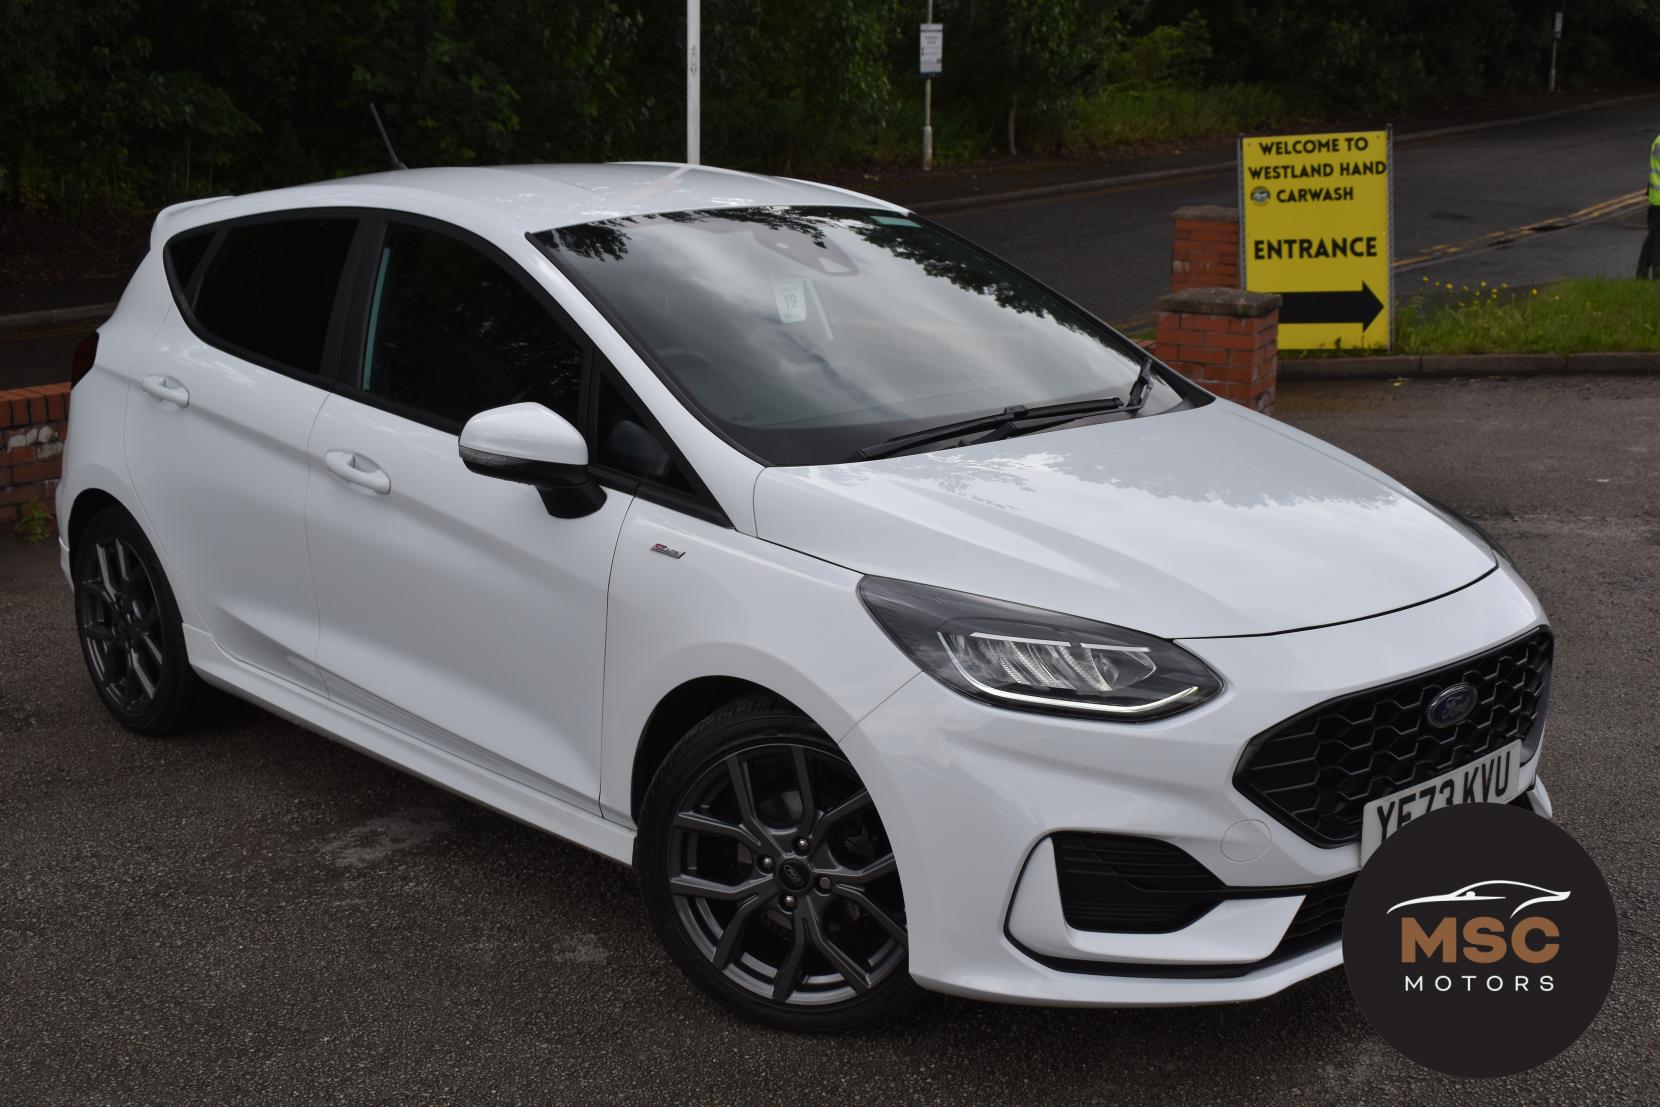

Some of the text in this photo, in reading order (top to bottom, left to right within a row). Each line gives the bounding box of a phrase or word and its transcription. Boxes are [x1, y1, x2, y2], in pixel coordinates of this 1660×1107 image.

[1259, 137, 1369, 156] WELCOME TO
[1248, 161, 1387, 180] WESTLAND HAND
[1276, 187, 1354, 203] CARWASH
[1254, 237, 1377, 260] ENTRANCE
[1463, 751, 1511, 804] KVU
